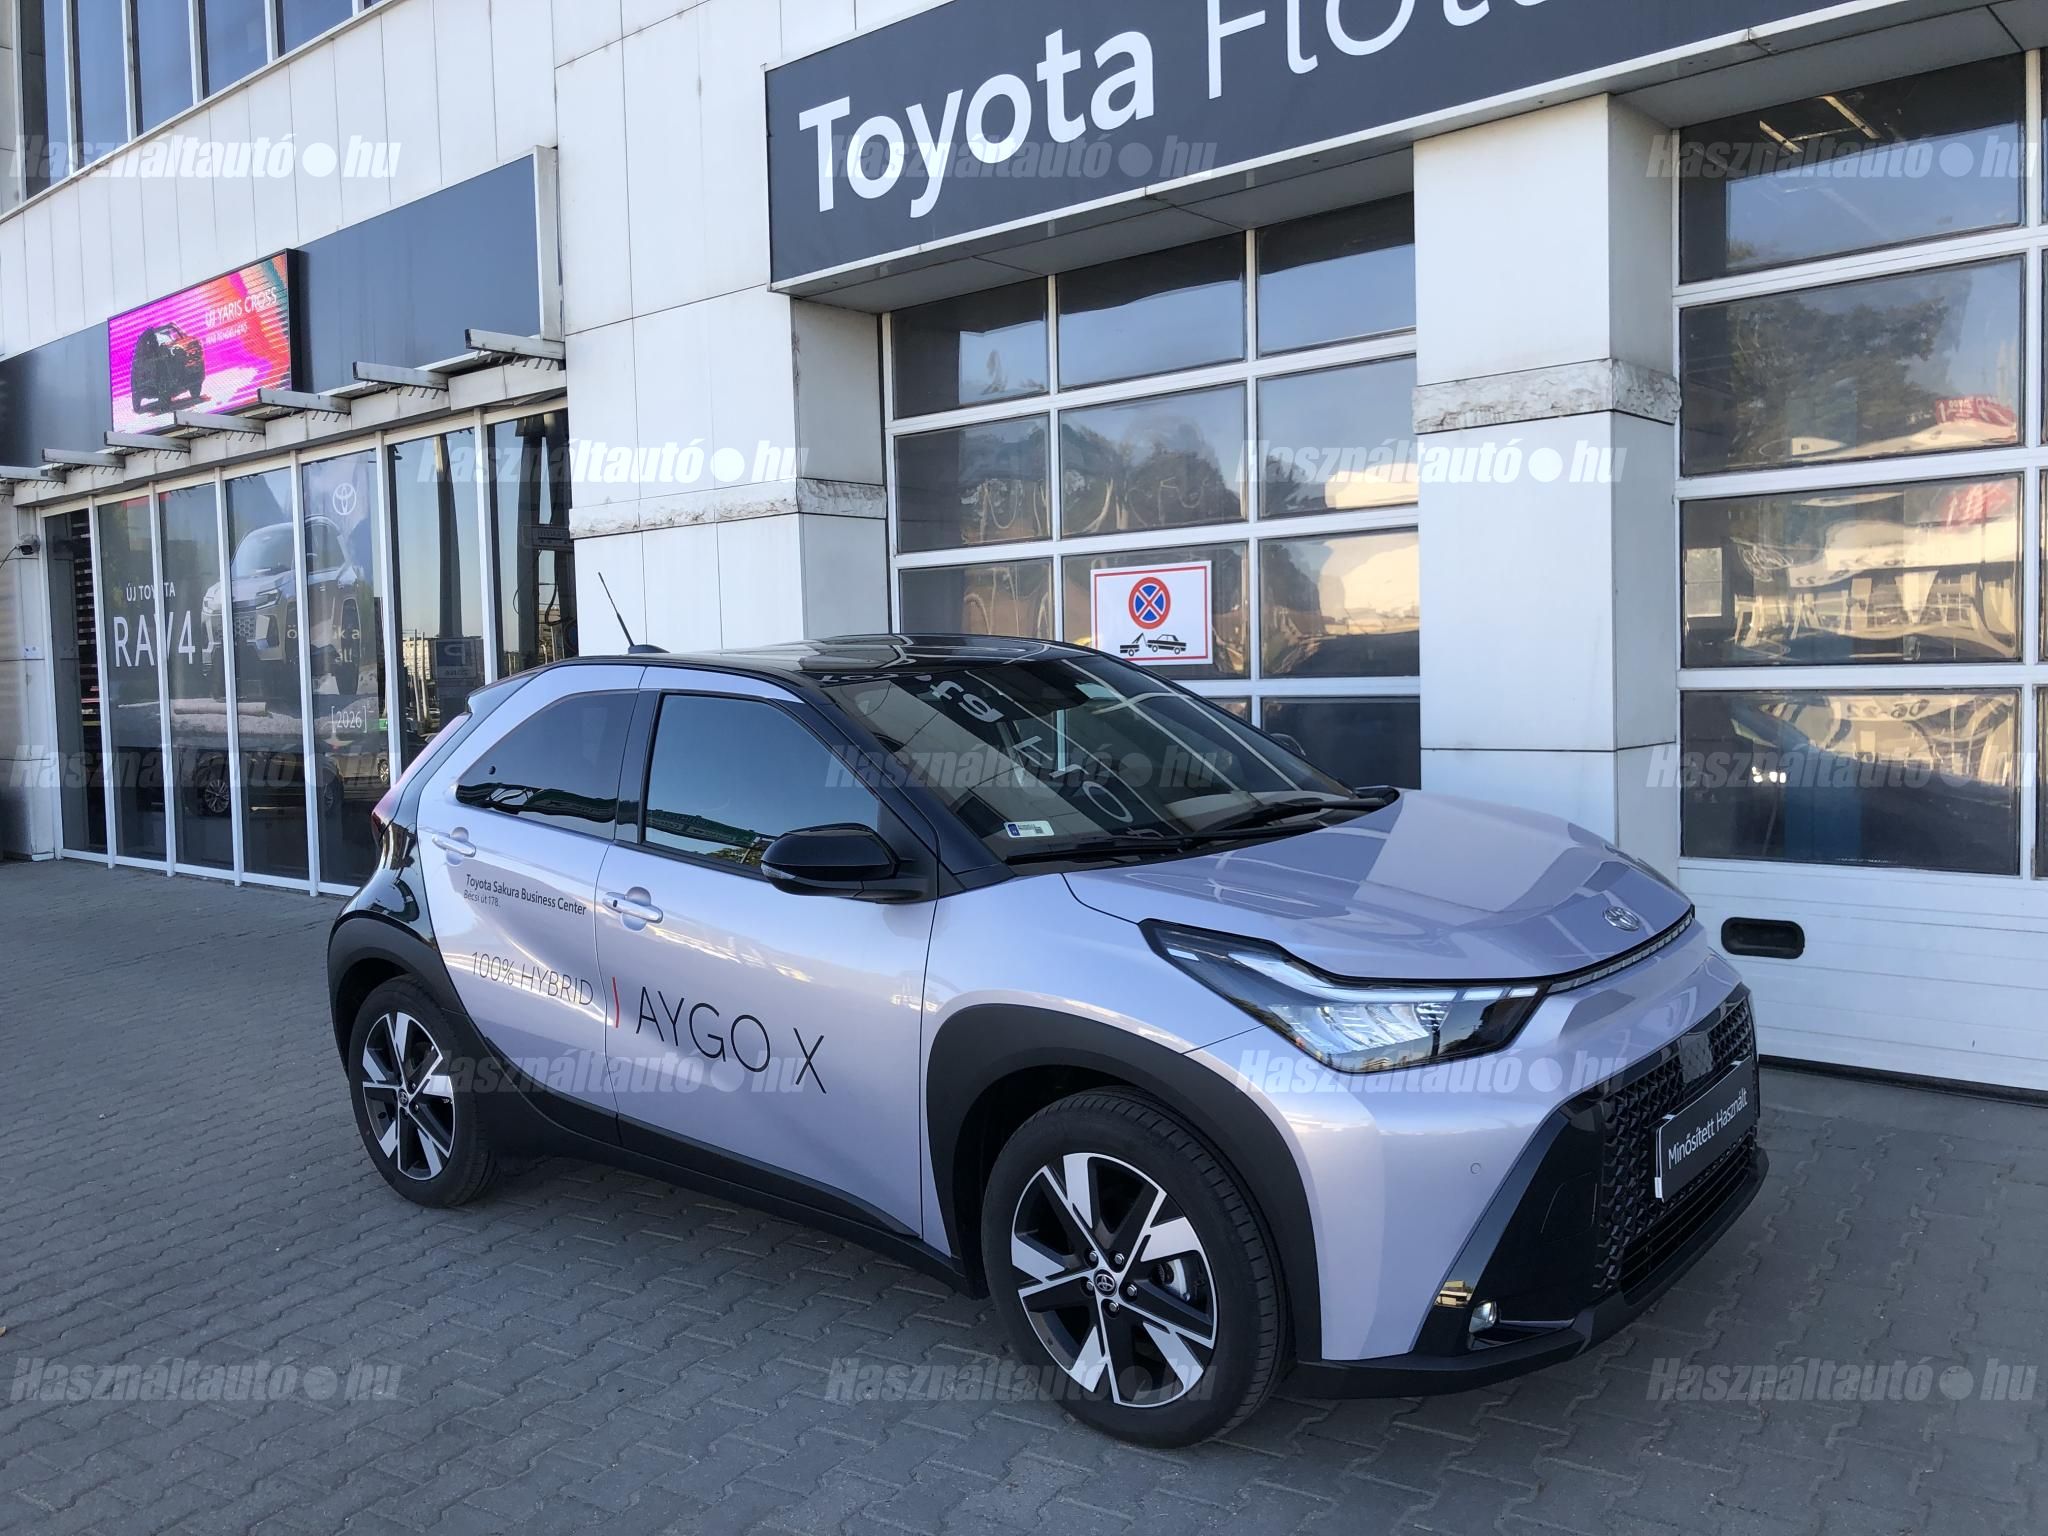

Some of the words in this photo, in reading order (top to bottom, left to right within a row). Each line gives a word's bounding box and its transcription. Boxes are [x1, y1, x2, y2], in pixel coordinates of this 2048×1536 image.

[799, 28, 1154, 219] Toyota
[217, 299, 243, 324] YARIS
[244, 287, 277, 313] CROSS
[126, 583, 137, 602] ÚJ
[138, 581, 176, 601] TOTA
[113, 610, 196, 667] RAV4
[466, 873, 492, 891] Toyota
[493, 880, 520, 899] Sakura
[521, 887, 556, 908] Business
[557, 897, 587, 916] Center
[471, 951, 515, 987] 100%
[519, 963, 595, 1007] HYBRID
[635, 985, 772, 1074] AYGO
[792, 1027, 827, 1094] X
[1668, 1118, 1716, 1170] Minősített
[1716, 1087, 1748, 1132] Használt
